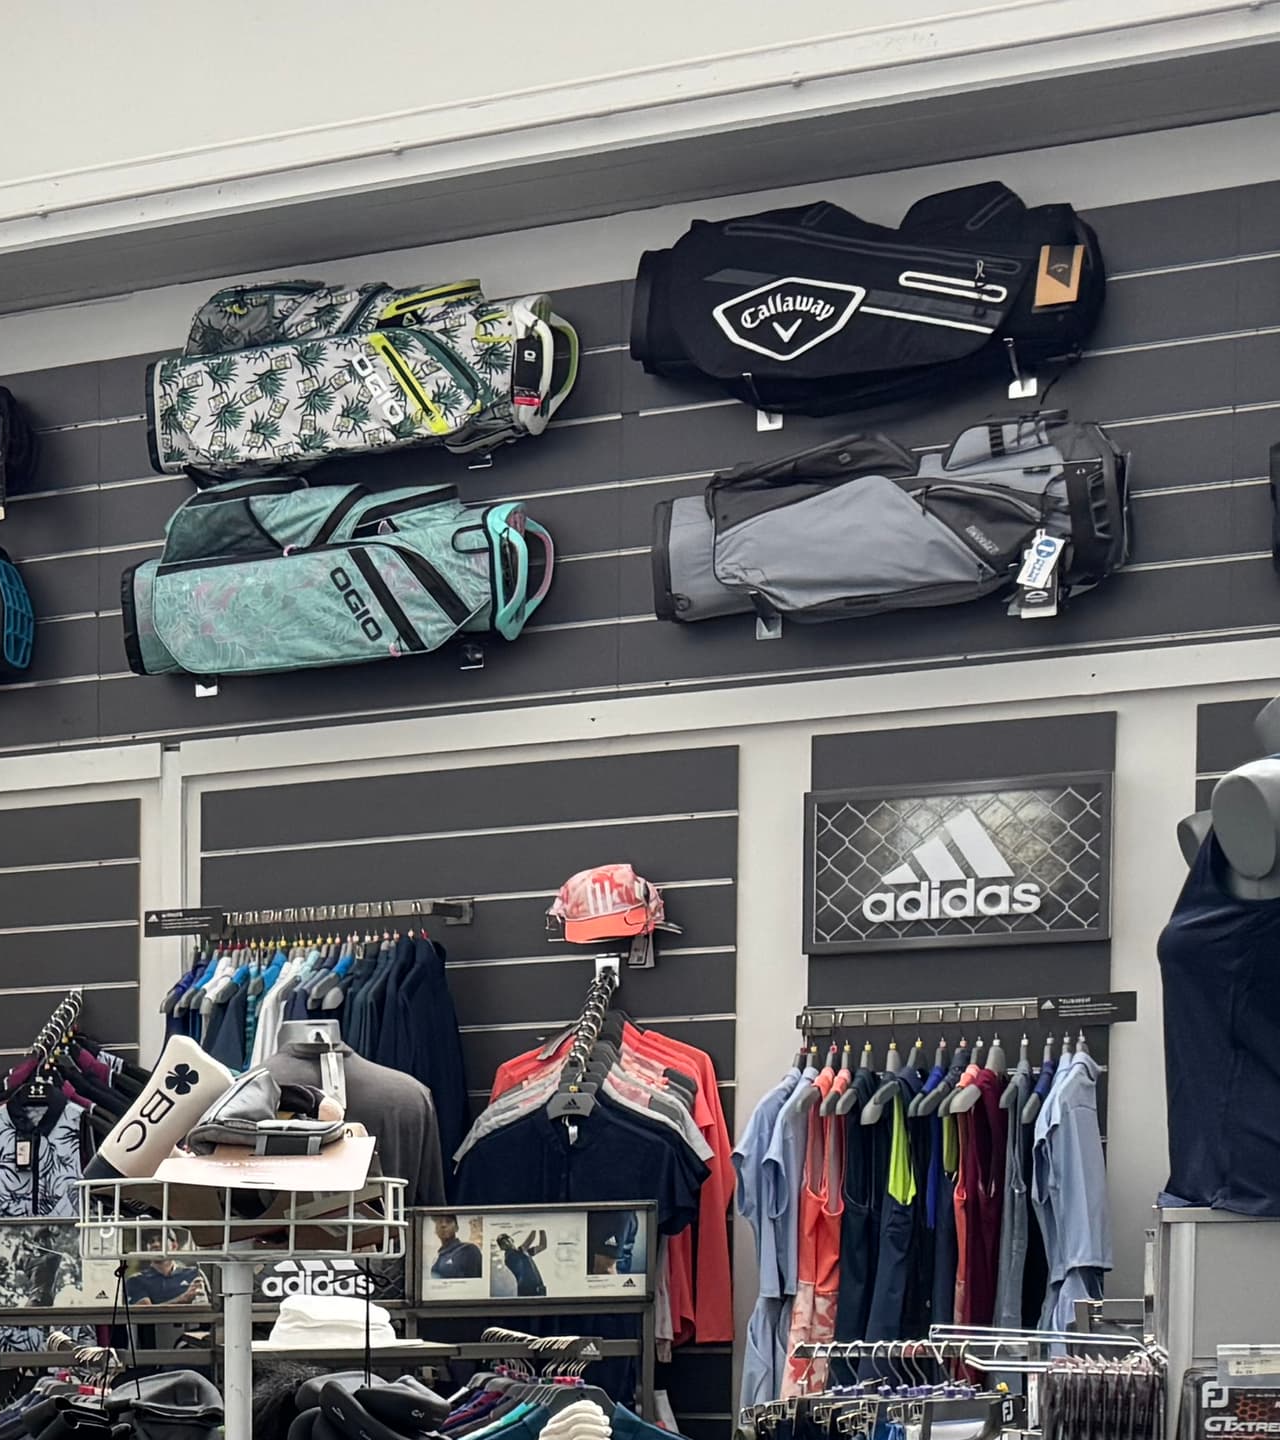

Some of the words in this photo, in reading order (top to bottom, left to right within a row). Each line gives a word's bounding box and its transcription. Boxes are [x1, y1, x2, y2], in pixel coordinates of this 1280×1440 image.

[740, 293, 835, 330] Callaway
[351, 353, 405, 426] OGIO
[329, 566, 383, 642] OGIO
[862, 877, 1041, 923] adidas
[261, 1269, 376, 1297] adidas
